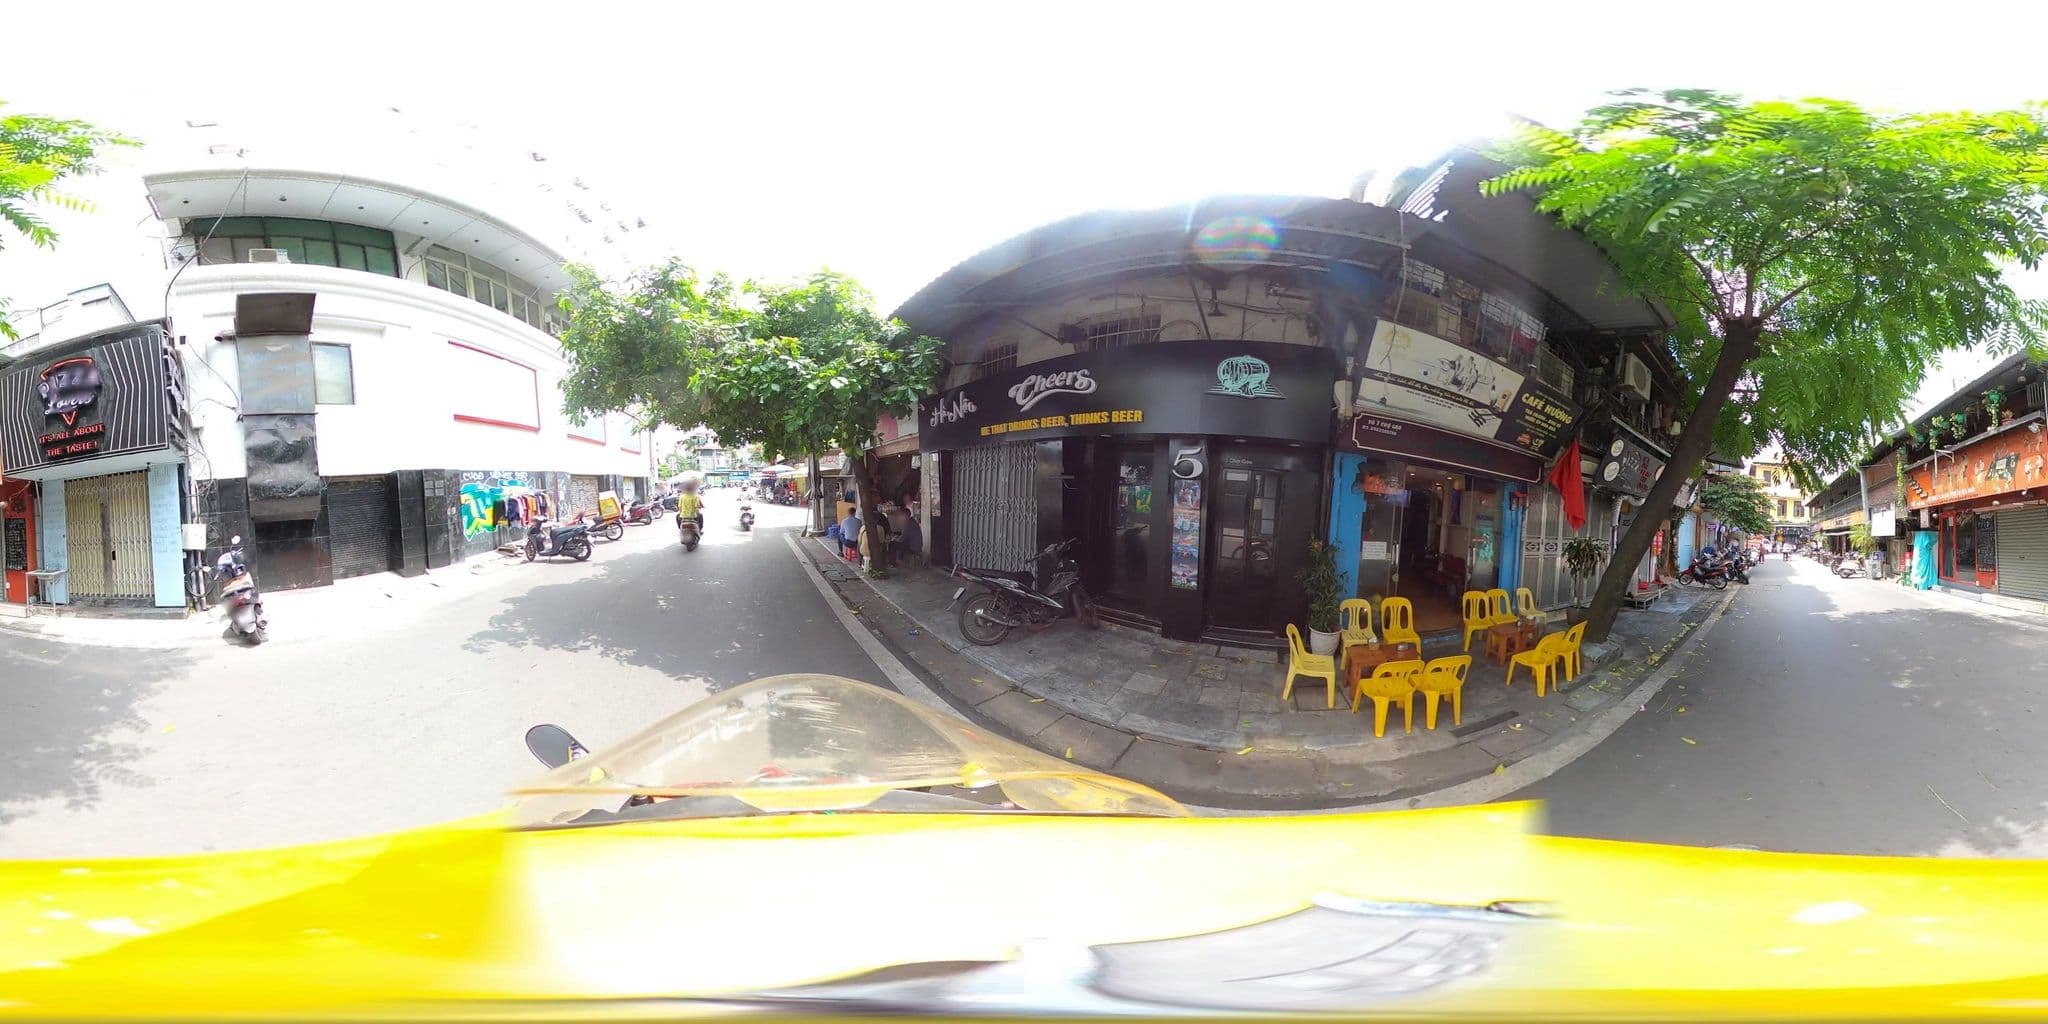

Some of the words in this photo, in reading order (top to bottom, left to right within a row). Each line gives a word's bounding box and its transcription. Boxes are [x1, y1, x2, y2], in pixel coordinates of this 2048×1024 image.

[1008, 368, 1097, 412] Cheers
[1521, 393, 1546, 410] CAFÉ
[56, 431, 69, 440] ALL
[74, 424, 103, 436] ABOUT
[991, 423, 1007, 434] THAT
[1008, 418, 1041, 432] DRINKS
[1069, 411, 1110, 425] THINKS
[1111, 409, 1143, 423] BEER
[47, 448, 62, 457] THE
[1172, 447, 1203, 478] 5
